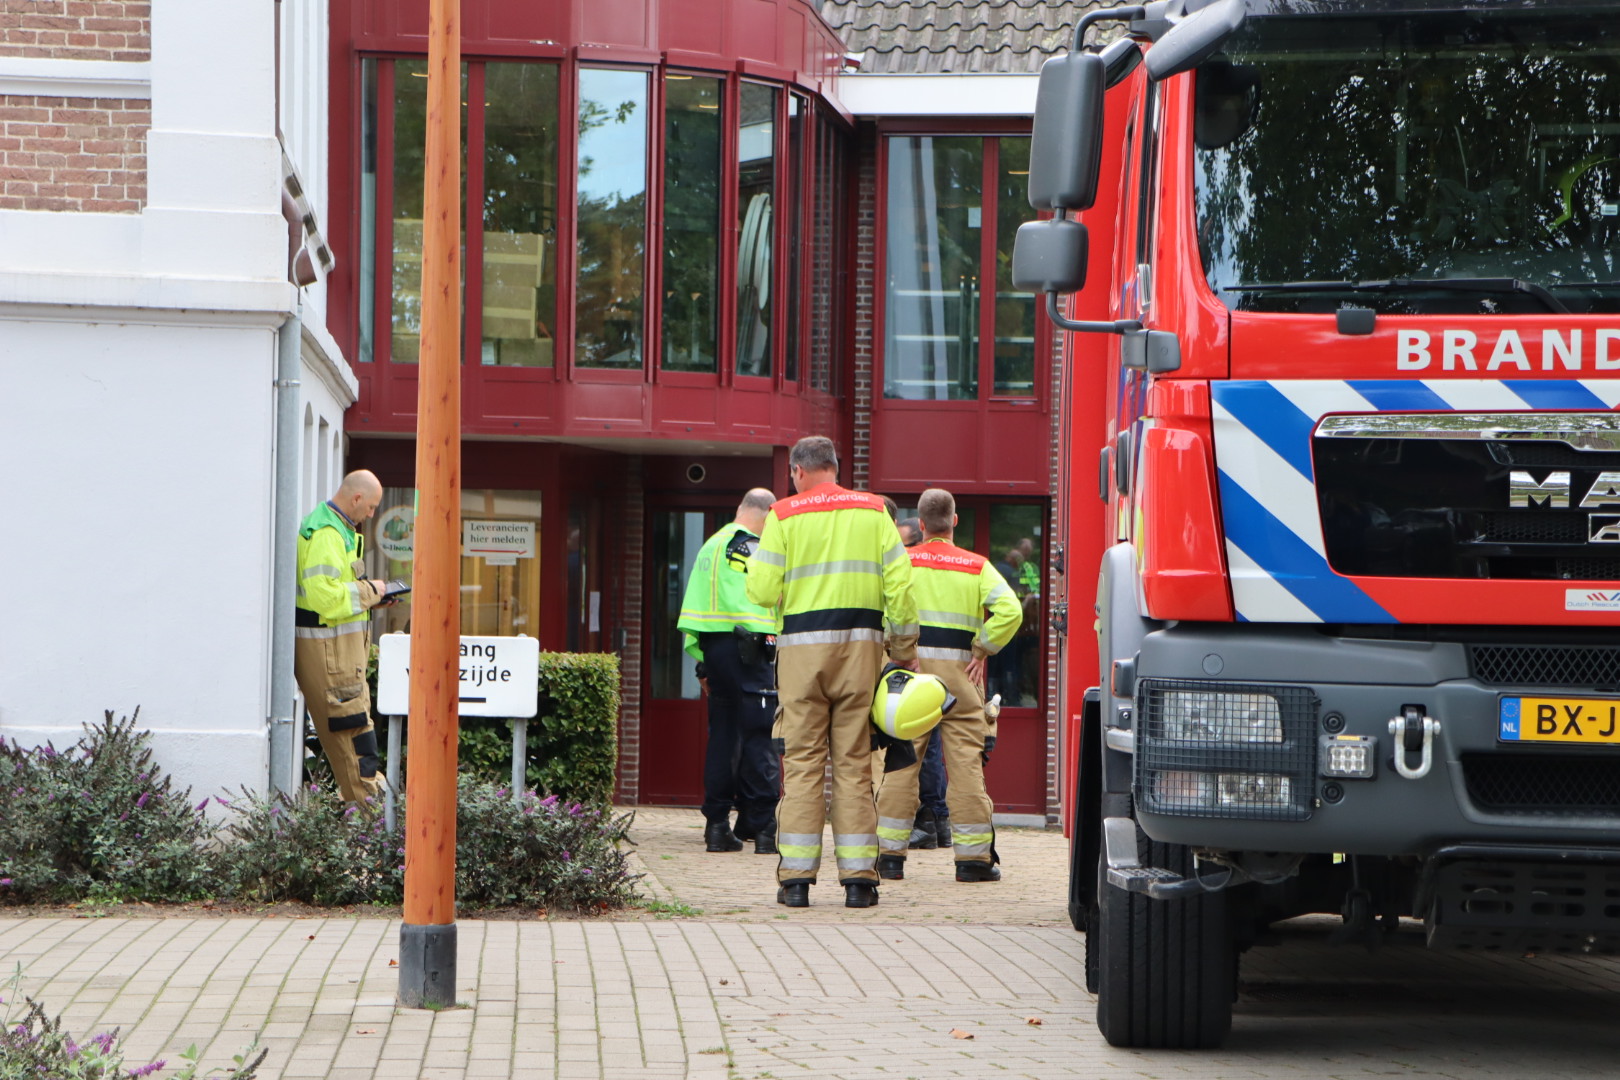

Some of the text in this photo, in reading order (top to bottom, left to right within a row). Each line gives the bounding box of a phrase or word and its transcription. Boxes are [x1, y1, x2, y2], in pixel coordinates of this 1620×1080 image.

[1396, 329, 1620, 371] BRAND
[1510, 471, 1620, 508] MA
[471, 522, 529, 533] Leveranciers
[470, 534, 526, 544] hier melden
[908, 551, 974, 566] evelvoerder
[459, 644, 496, 663] ang
[1502, 722, 1517, 733] NL
[1536, 704, 1616, 737] BX-J
